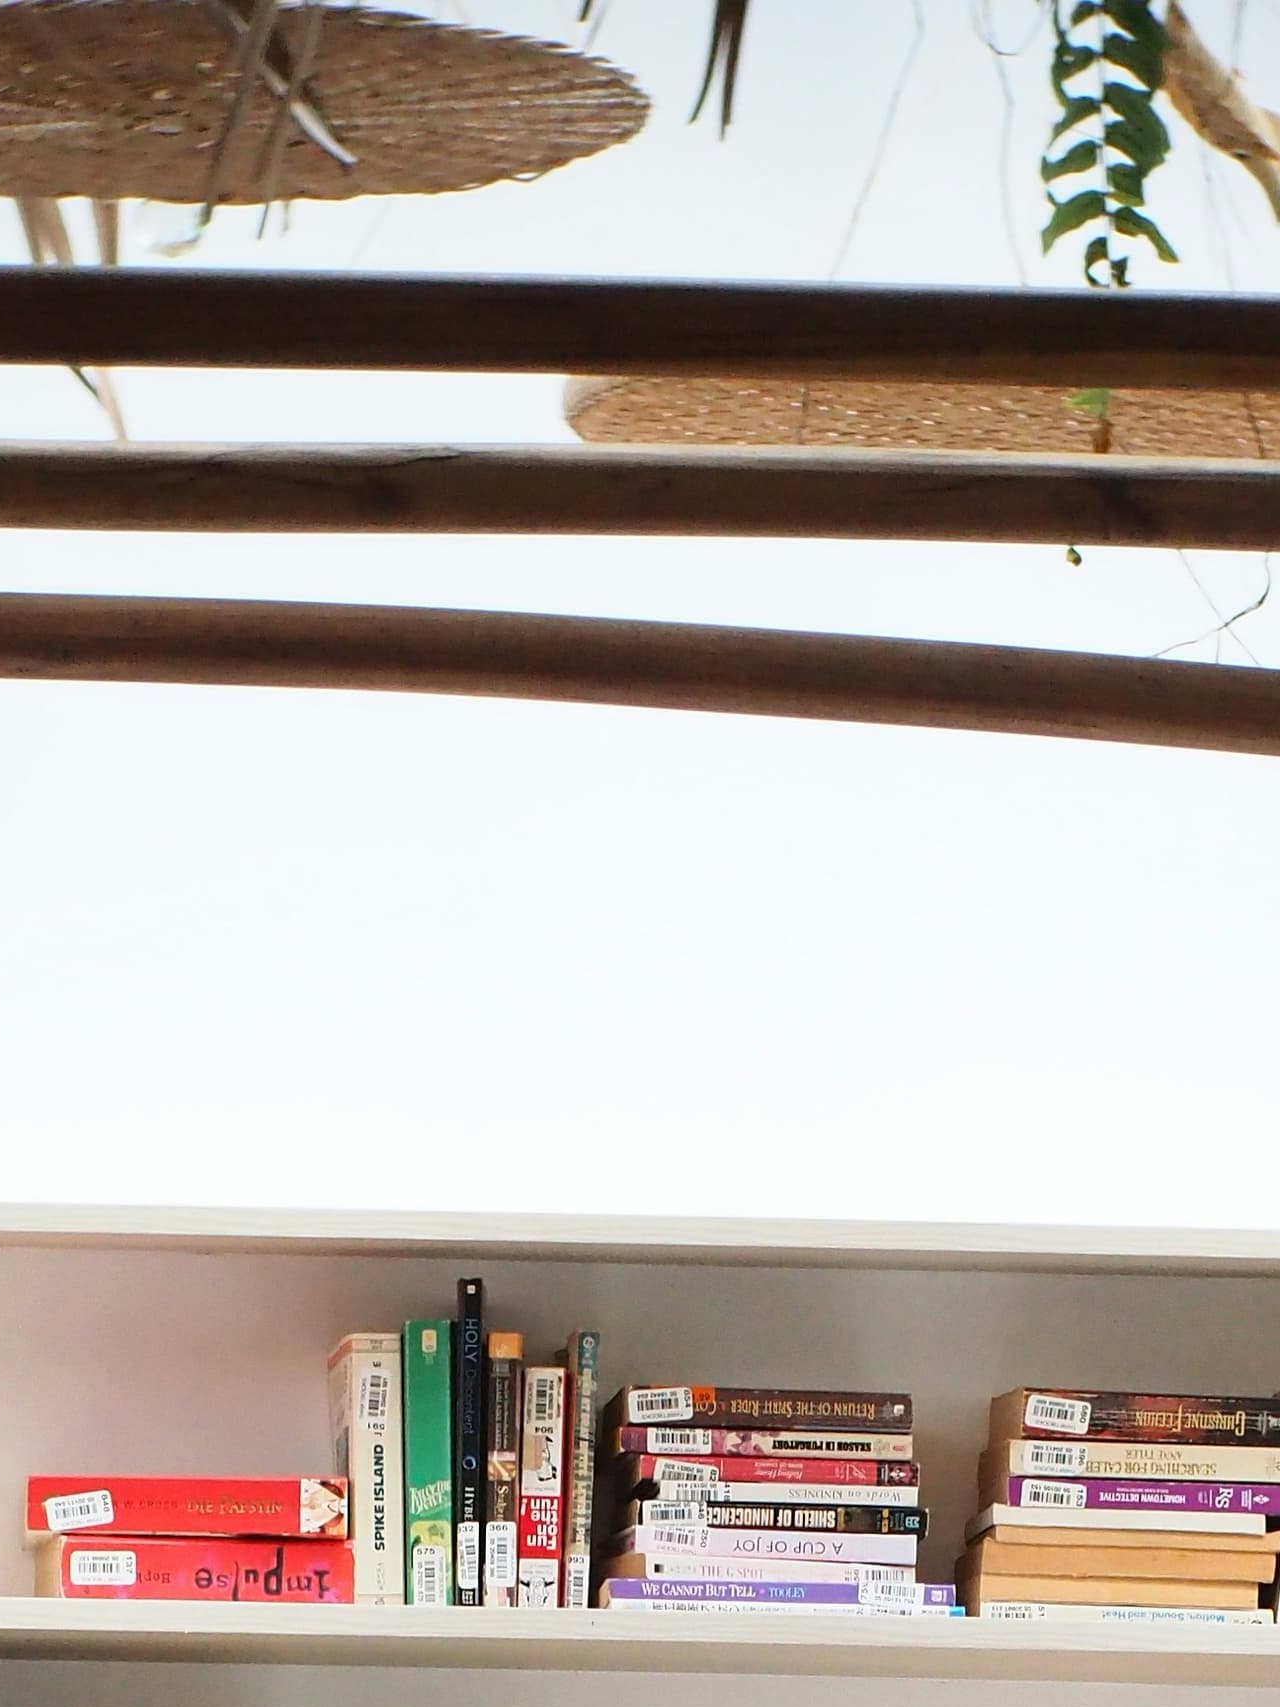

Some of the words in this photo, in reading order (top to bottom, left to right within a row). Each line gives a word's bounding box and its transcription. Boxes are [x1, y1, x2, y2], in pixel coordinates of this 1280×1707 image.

[374, 1444, 385, 1500] ISLAND
[1085, 1460, 1122, 1473] CALEB
[1124, 1461, 1153, 1473] FOR
[1159, 1461, 1218, 1475] SEARCHING
[1099, 1491, 1139, 1502] DETECTIVE
[1140, 1492, 1186, 1504] HOMETOWN
[531, 1512, 558, 1523] the
[707, 1506, 775, 1527] INNOCENCE
[777, 1508, 792, 1527] OF
[794, 1508, 837, 1528] SHIELD
[374, 1503, 386, 1551] SPIKE
[537, 1524, 557, 1535] on
[527, 1534, 557, 1549] Fun
[732, 1538, 763, 1553] JOY
[767, 1541, 788, 1553] OF
[793, 1542, 826, 1554] CUP
[832, 1543, 843, 1554] A
[194, 1546, 330, 1602] impulse
[641, 1584, 660, 1596] WE
[662, 1584, 703, 1597] CANNOT
[706, 1584, 727, 1597] BUT
[728, 1584, 756, 1598] TELL
[768, 1586, 807, 1599] TOOLEY
